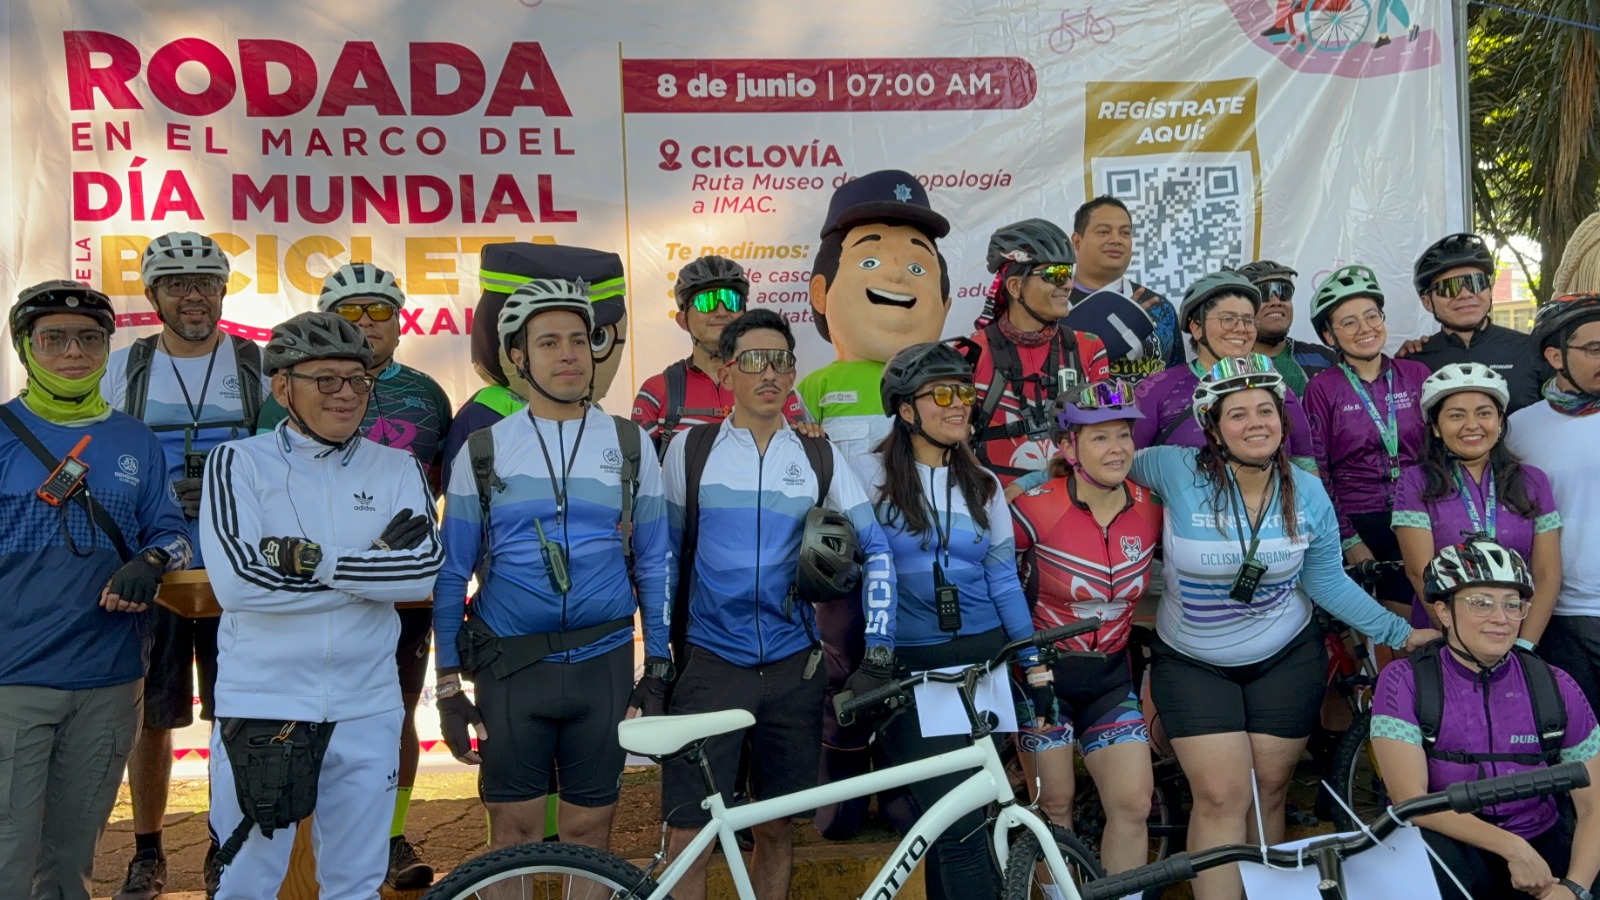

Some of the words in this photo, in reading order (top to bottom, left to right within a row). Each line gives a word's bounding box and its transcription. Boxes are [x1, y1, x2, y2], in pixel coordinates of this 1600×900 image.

[63, 31, 573, 118] RODADA
[657, 73, 678, 98] 8
[687, 73, 728, 98] de
[735, 72, 817, 102] junio
[847, 74, 935, 97] 07:00
[946, 73, 1000, 96] AM.
[1097, 96, 1246, 120] REGÍSTRATE
[72, 121, 132, 153] EN
[166, 123, 228, 155] EL
[262, 127, 447, 157] MARCO
[480, 127, 575, 156] DEL
[1136, 118, 1206, 145] AQUÍ:
[691, 138, 844, 168] CICLOVÍA
[73, 156, 205, 222] DÍA
[232, 173, 578, 225] MUNDIAL
[692, 174, 744, 191] Ruta
[752, 173, 825, 190] Museo
[692, 200, 705, 214] a
[713, 196, 777, 214] IMAC.
[75, 237, 91, 262] LA
[666, 243, 692, 260] Te
[700, 241, 810, 260] pedimos:
[74, 269, 91, 288] E
[769, 271, 811, 283] casc
[757, 291, 813, 305] acom
[353, 504, 377, 512] adidas
